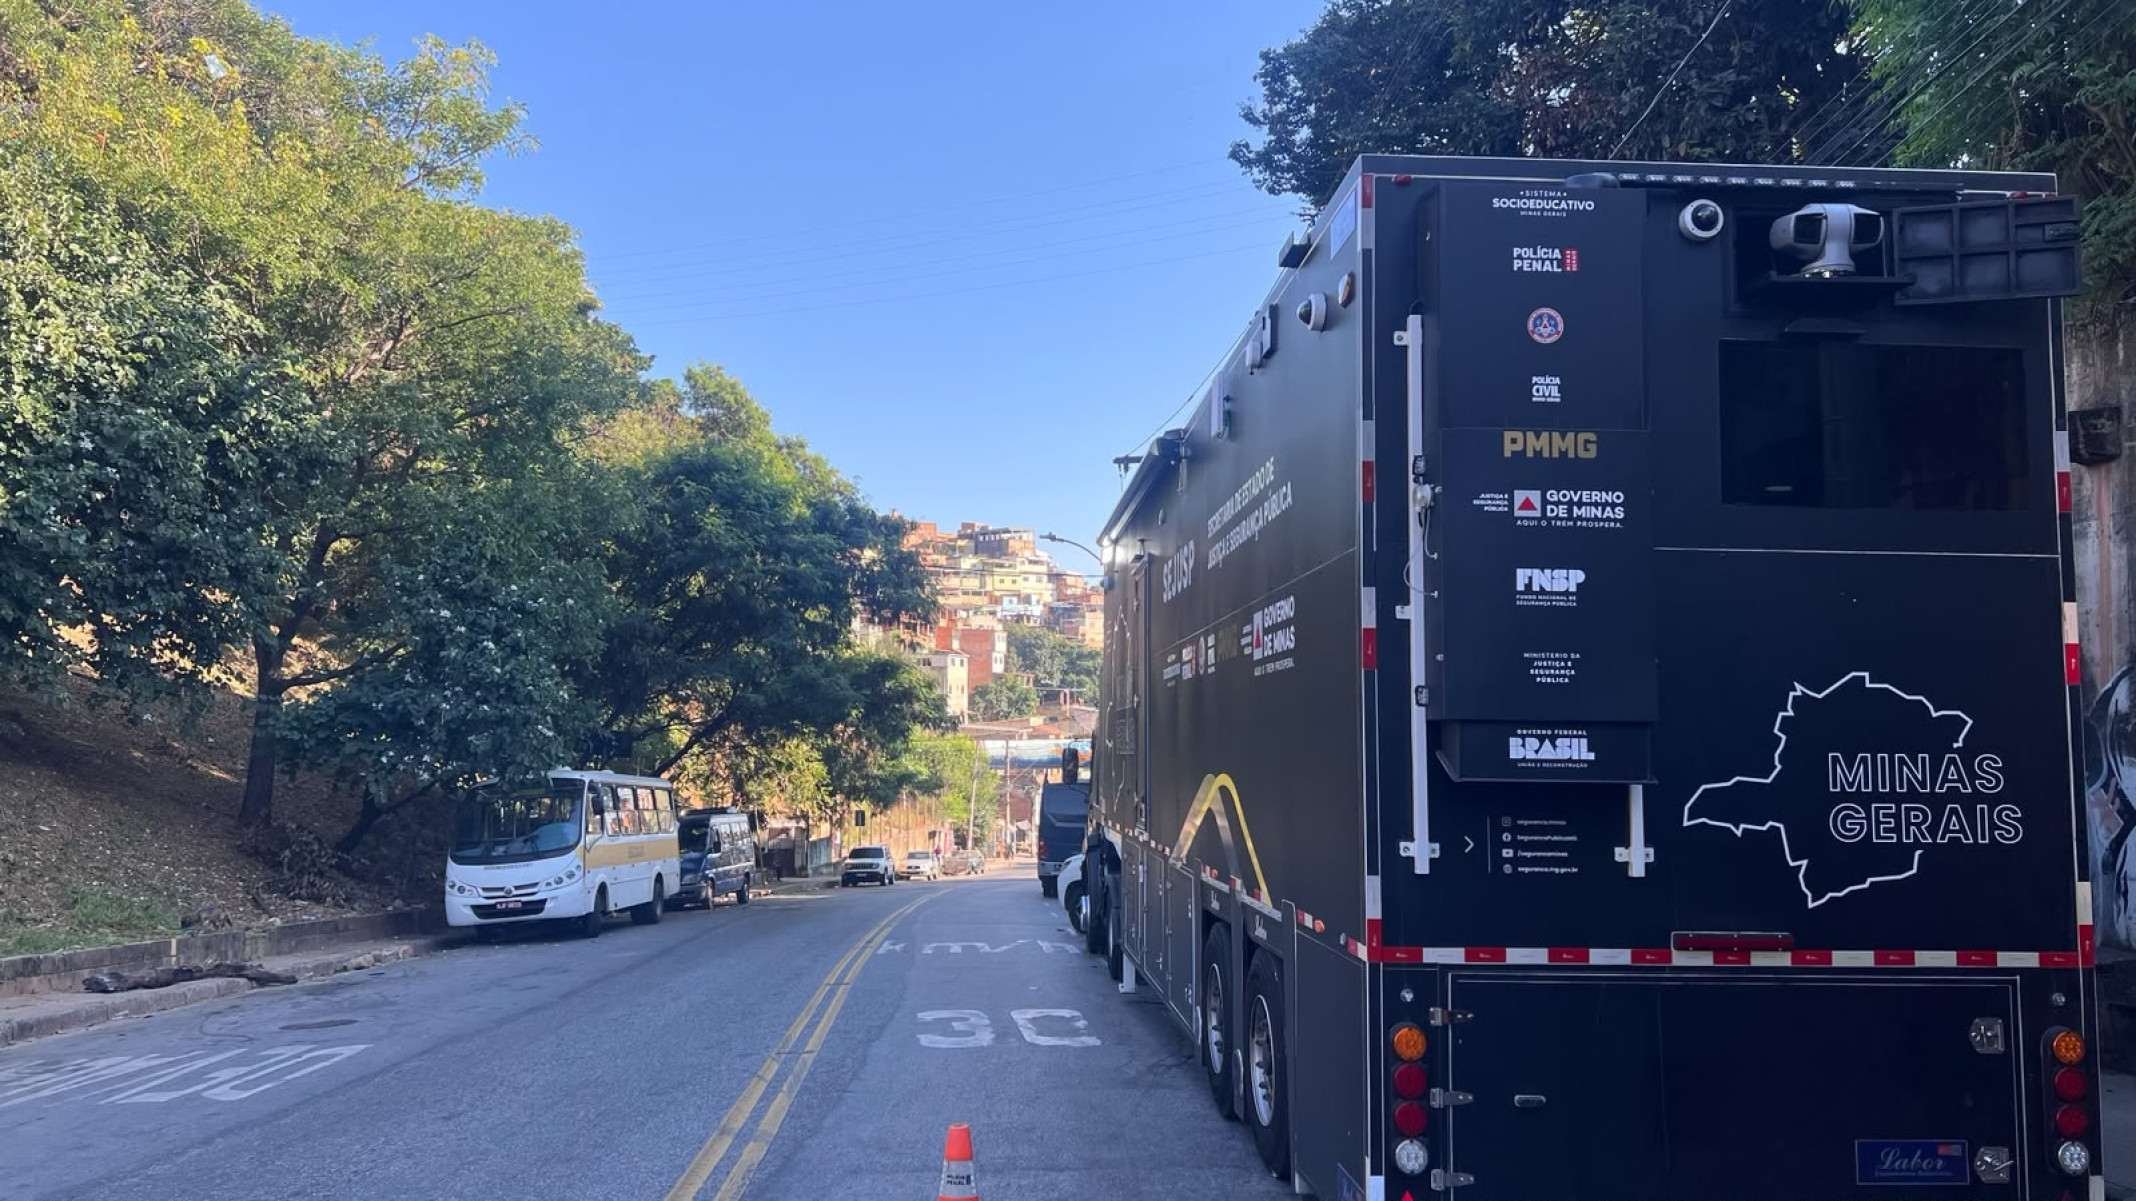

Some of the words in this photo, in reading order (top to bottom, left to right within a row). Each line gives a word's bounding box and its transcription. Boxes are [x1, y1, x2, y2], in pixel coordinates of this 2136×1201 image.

[1492, 197, 1595, 211] SOCIOEDUCATIVO
[1513, 245, 1562, 259] POLÍCIA
[1513, 259, 1562, 272] PENAL
[1532, 375, 1560, 384] POLÍCIA
[1532, 385, 1561, 397] CIVIL
[1503, 430, 1598, 459] PMMG
[1546, 490, 1625, 504] GOVERNO
[1516, 519, 1538, 527] AQUI
[1540, 519, 1548, 527] O
[1546, 505, 1569, 518] DE
[1572, 505, 1625, 519] MINAS
[1162, 540, 1195, 604] SEJUSP
[1516, 568, 1586, 592] FNSP
[1263, 595, 1296, 629] GOVERNO
[1263, 633, 1273, 658] DE
[1273, 624, 1296, 655] MINAS
[1509, 736, 1595, 760] BRASIL
[1828, 752, 2005, 793] MINAS
[1829, 803, 2024, 844] GERAIS
[1880, 1146, 1946, 1170] Labor
